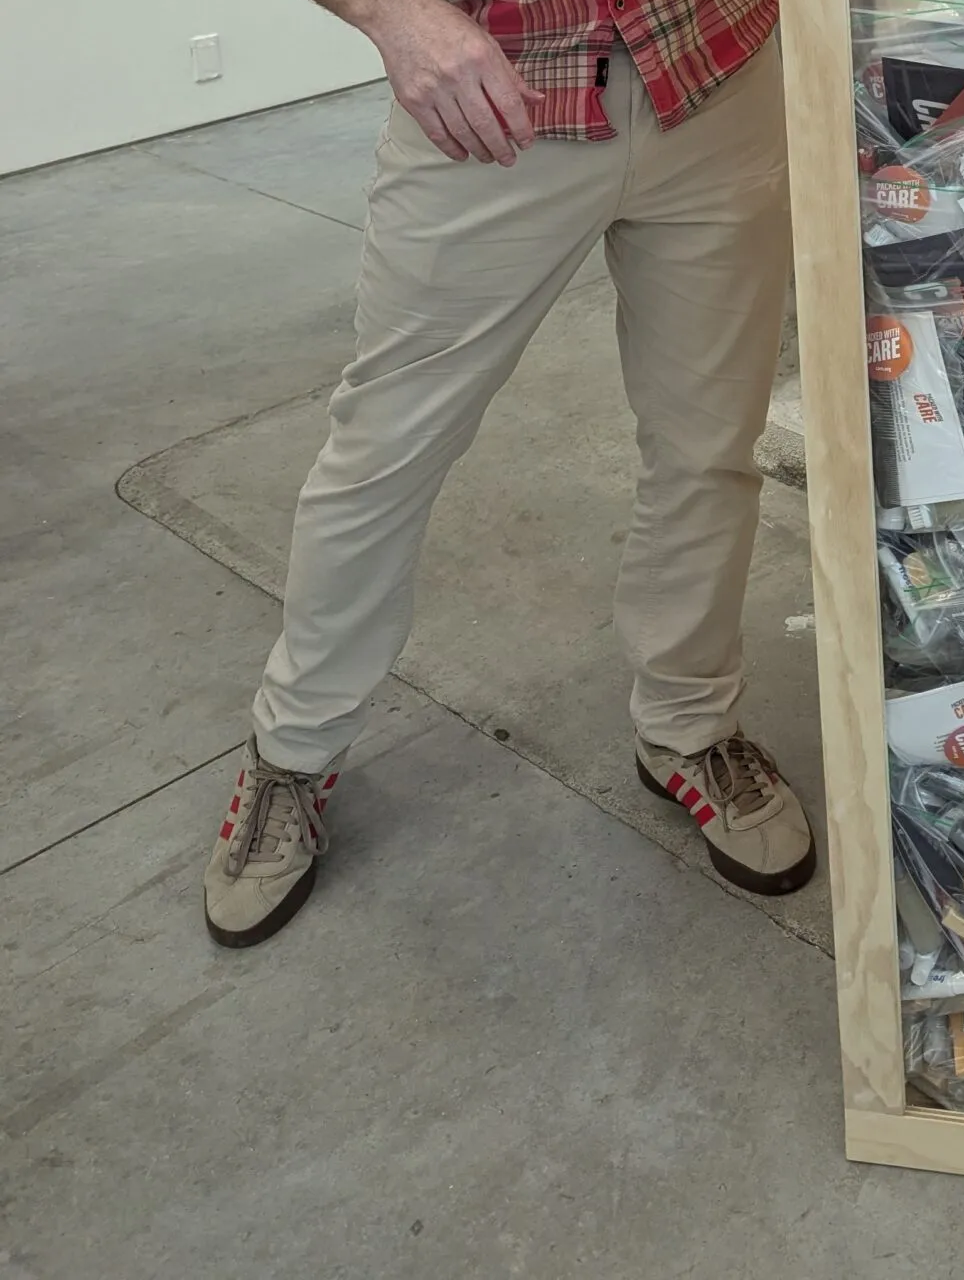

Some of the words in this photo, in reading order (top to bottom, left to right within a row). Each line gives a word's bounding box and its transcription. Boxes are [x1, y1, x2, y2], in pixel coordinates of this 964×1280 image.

[876, 180, 902, 192] PACKED
[876, 189, 920, 209] CARE
[883, 327, 900, 339] WITH
[912, 393, 937, 424] CARE
